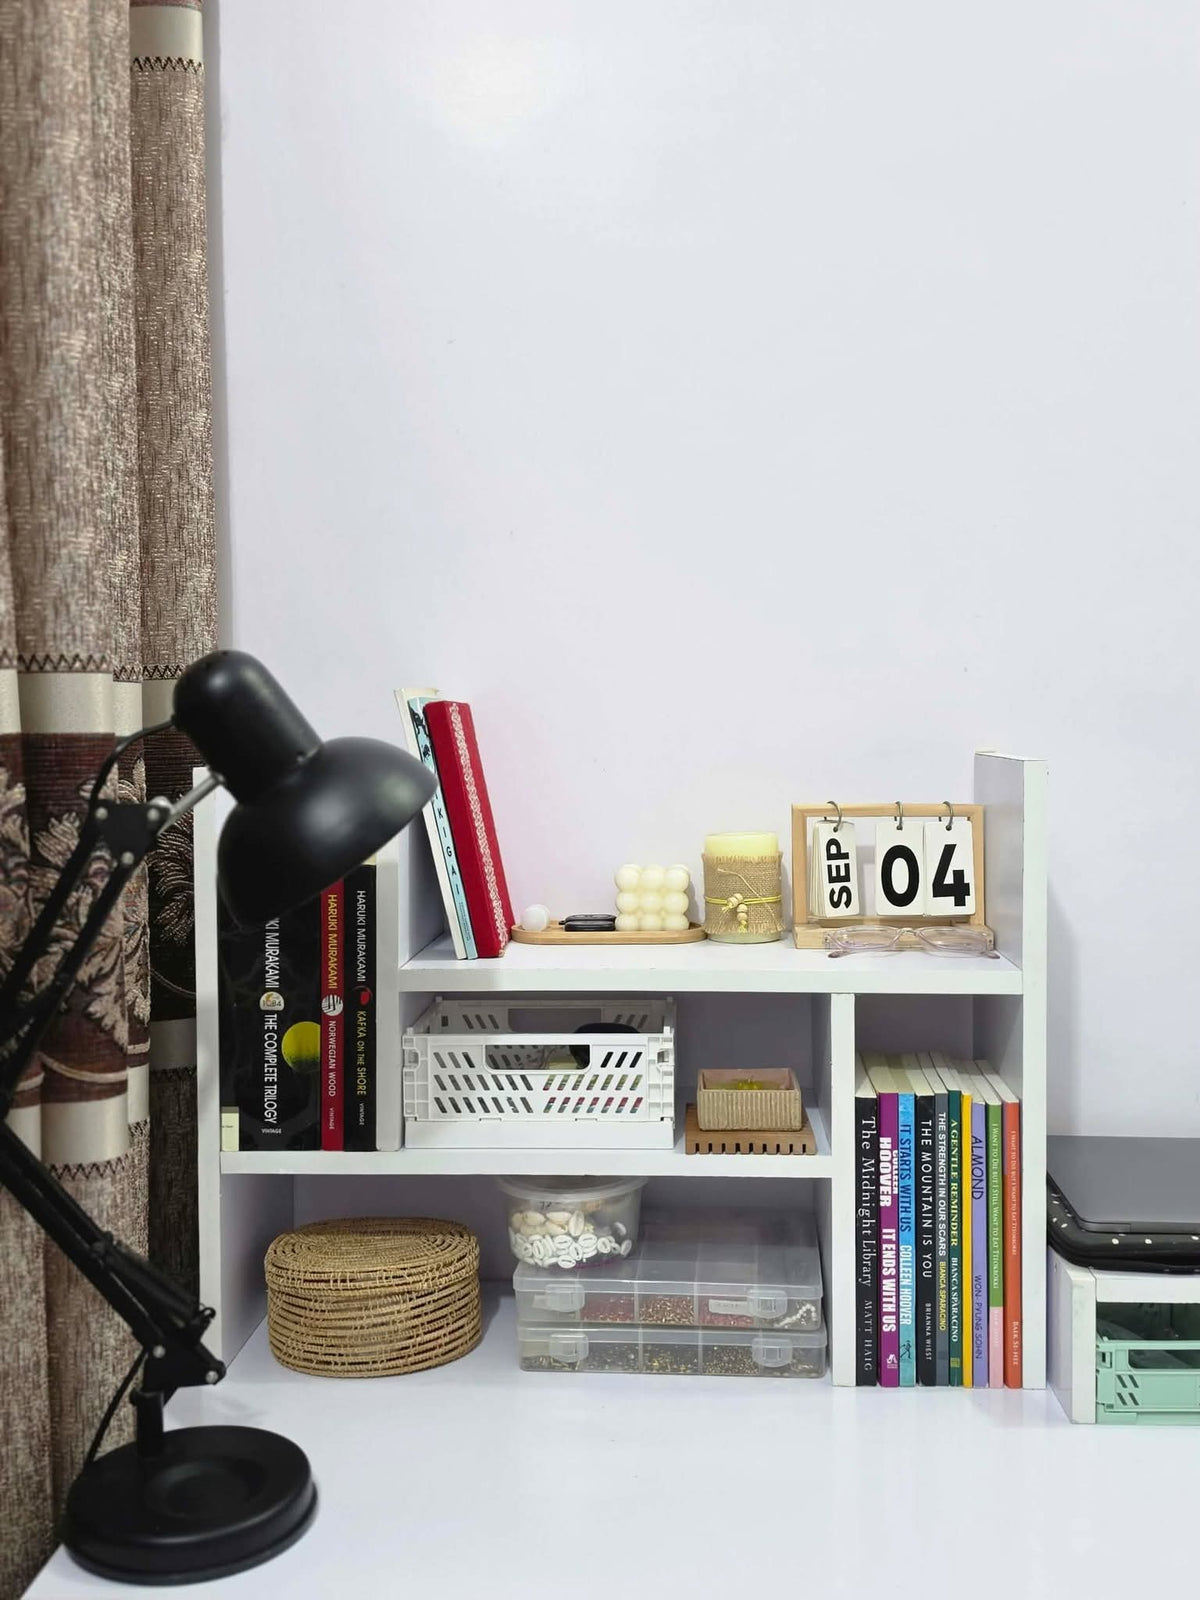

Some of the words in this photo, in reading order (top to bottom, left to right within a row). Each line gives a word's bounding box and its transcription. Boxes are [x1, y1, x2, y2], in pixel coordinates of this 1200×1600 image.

[826, 838, 852, 908] SEP
[328, 894, 338, 931] HARUKI
[356, 890, 366, 926] HARUKI
[265, 932, 280, 988] MURAKAMI
[328, 933, 338, 989] MURAKAMI
[356, 928, 366, 982] MURAKAMI
[264, 1013, 278, 1030] THE
[357, 1010, 366, 1038] KAFKA
[264, 1032, 278, 1082] COMPLETE
[328, 1020, 337, 1069] NORWEGIAN
[357, 1041, 365, 1052] ON
[357, 1053, 365, 1065] THE
[328, 1072, 337, 1097] WOOD
[357, 1067, 366, 1095] SHORE
[264, 1085, 278, 1124] TRILOGY
[938, 1112, 946, 1131] THE
[861, 1116, 877, 1150] The
[900, 1124, 911, 1135] IT
[921, 1120, 932, 1146] THE
[951, 1119, 959, 1128] A
[879, 1137, 892, 1207] HOOVER
[900, 1138, 911, 1181] STARTS
[938, 1133, 946, 1186] STRENGTH
[951, 1130, 959, 1180] GENTLE
[971, 1135, 984, 1200] ALMOND
[858, 1157, 876, 1235] Midnight
[900, 1184, 911, 1214] WITH
[921, 1151, 932, 1228] MOUNTAIN
[938, 1188, 946, 1197] IN
[900, 1217, 911, 1232] US
[938, 1201, 946, 1221] OUR
[951, 1183, 959, 1246] REMINDER
[882, 1228, 896, 1239] IT
[921, 1234, 932, 1246] IS
[938, 1223, 946, 1256] SCARS
[858, 1240, 877, 1287] Library
[882, 1243, 896, 1276] ENDS
[900, 1245, 912, 1285] COLLEEN
[921, 1253, 932, 1278] YOU
[882, 1278, 896, 1312] WITH
[900, 1288, 912, 1325] HOOVER
[864, 1300, 873, 1334] MATT
[882, 1315, 896, 1332] US
[864, 1340, 873, 1371] HAIG
